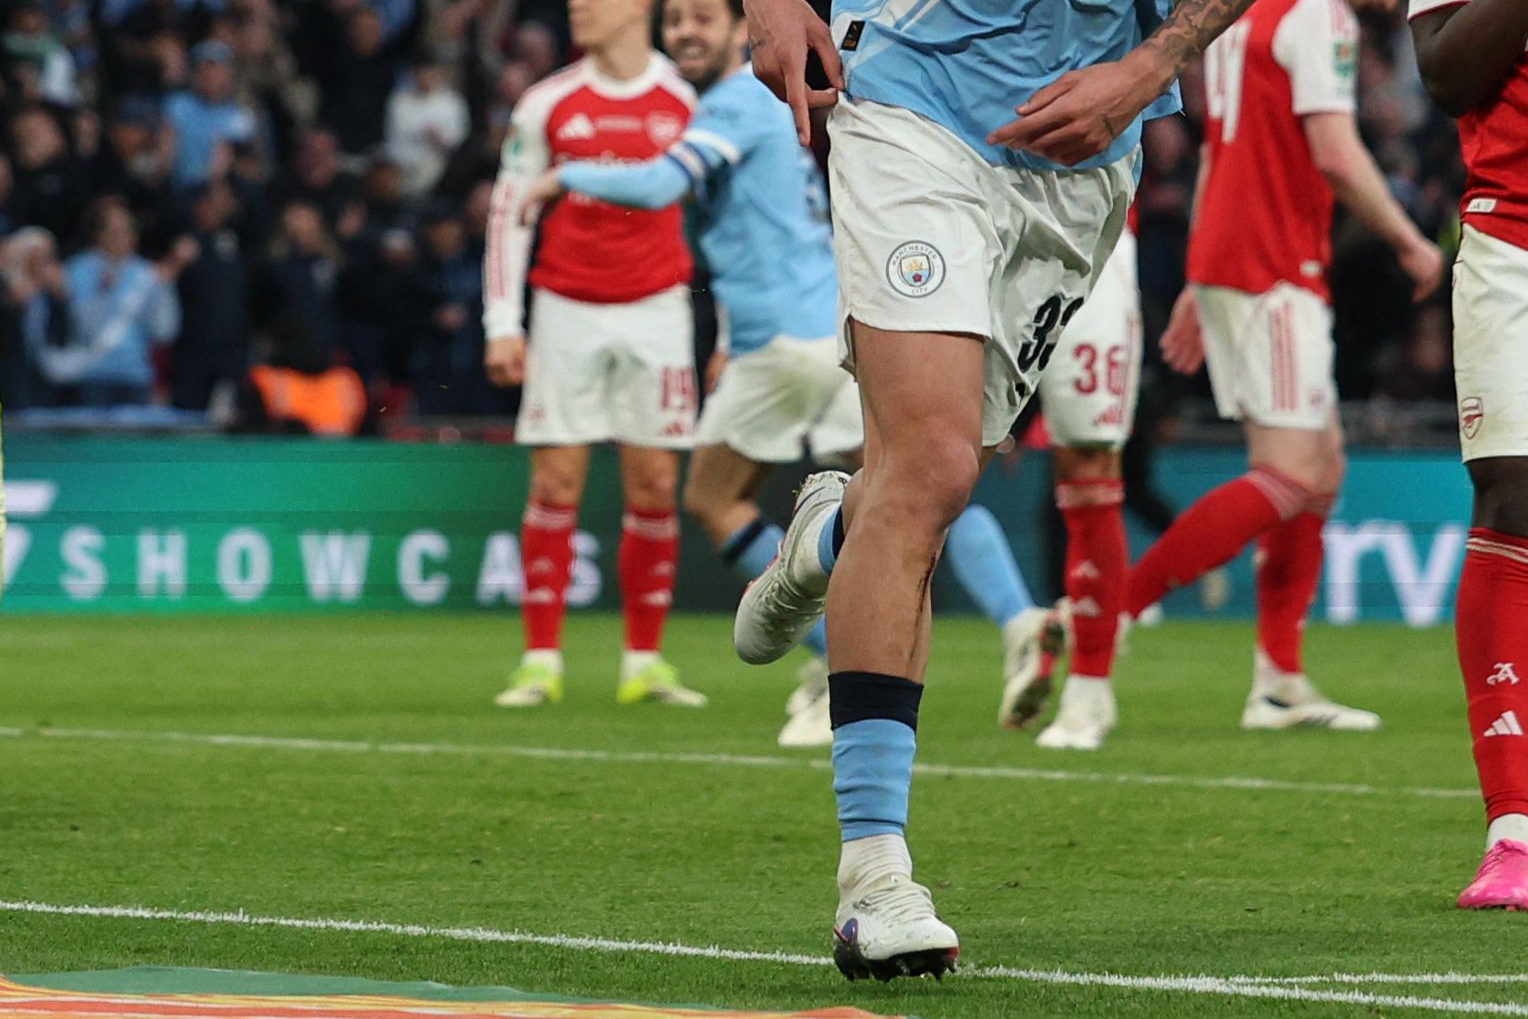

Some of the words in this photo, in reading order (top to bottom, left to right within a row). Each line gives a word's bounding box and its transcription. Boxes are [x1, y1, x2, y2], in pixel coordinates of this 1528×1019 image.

[892, 244, 938, 266] MANCHESTER
[911, 286, 929, 295] CITY
[1072, 341, 1127, 396] 36
[59, 525, 602, 604] SHOWCAS
